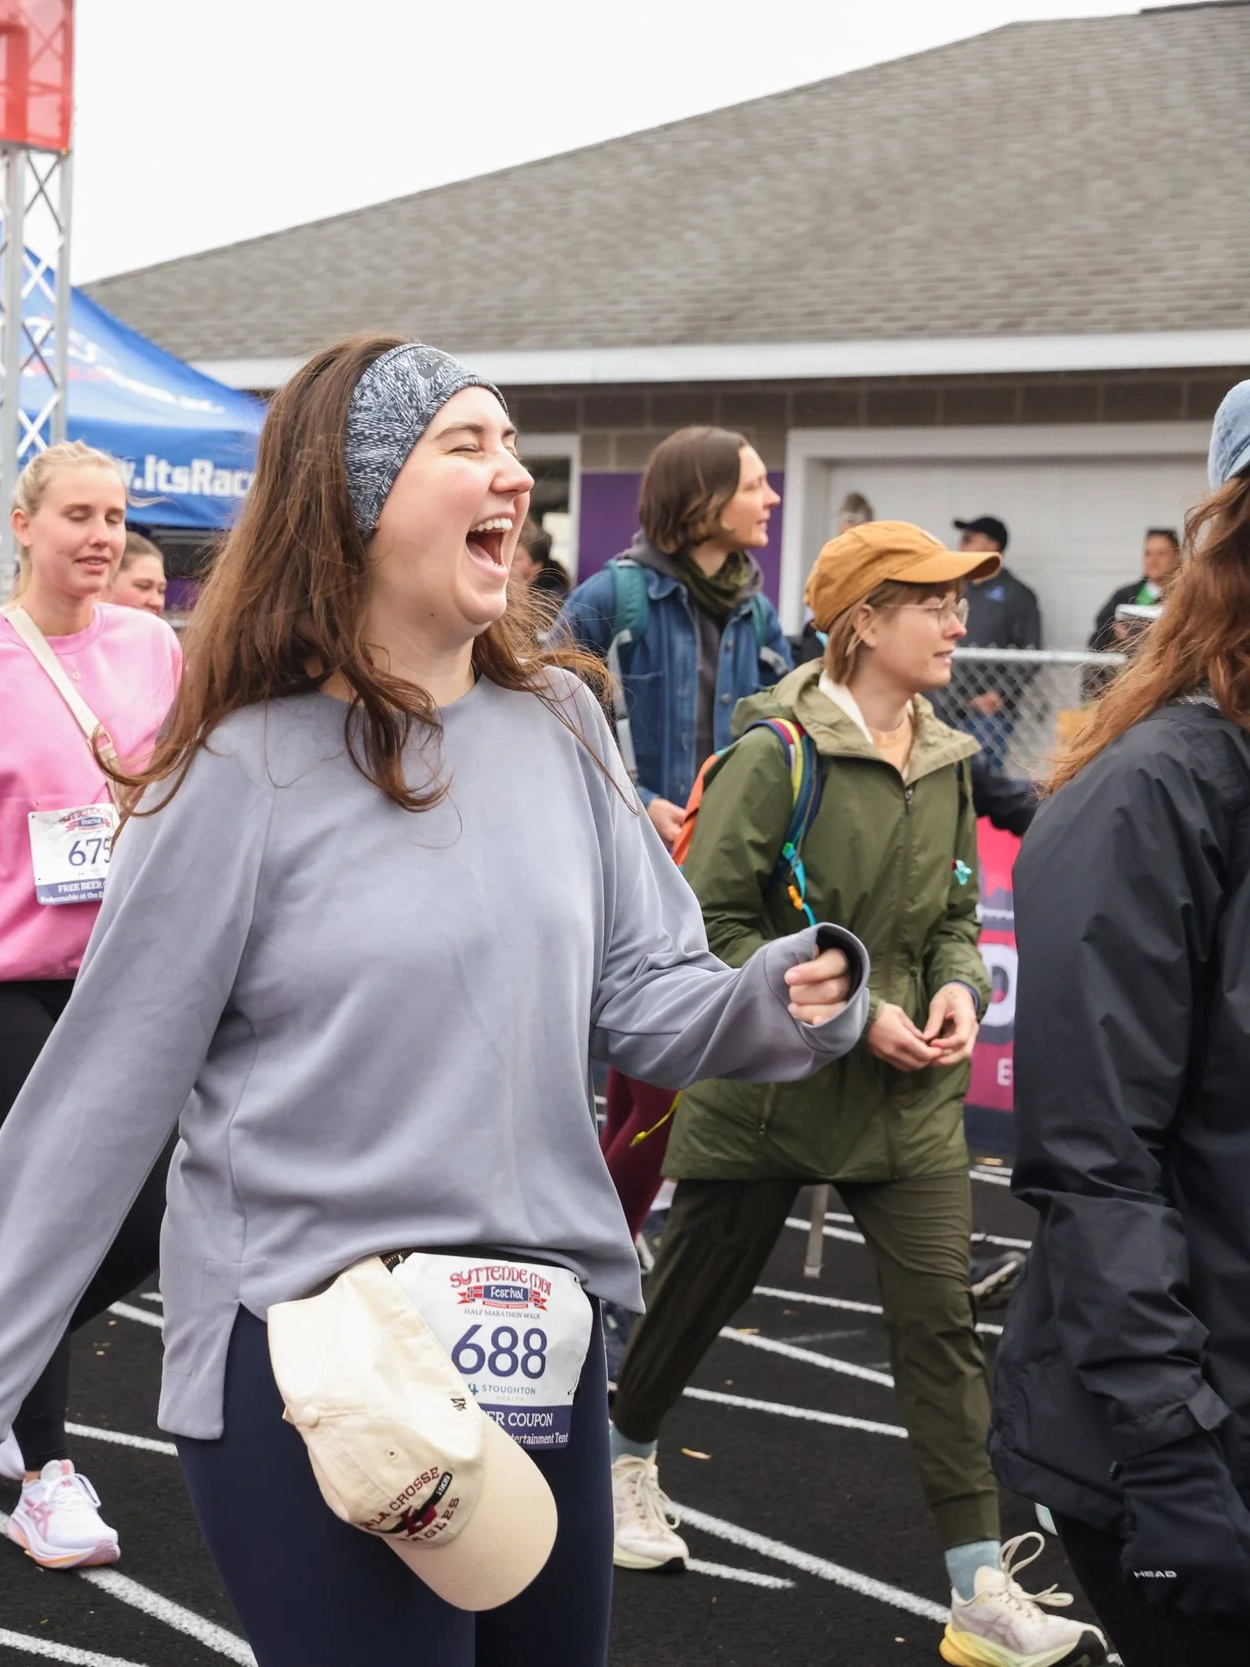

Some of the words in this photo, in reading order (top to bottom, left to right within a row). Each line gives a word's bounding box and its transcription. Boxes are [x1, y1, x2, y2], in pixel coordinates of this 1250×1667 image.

[68, 837, 111, 867] 675
[484, 1309, 522, 1318] MARATHON
[523, 1312, 541, 1320] WALK
[451, 1324, 548, 1380] 688
[482, 1384, 536, 1395] STOUGHTON
[507, 1412, 554, 1428] COUPON
[511, 1433, 554, 1445] tertainment
[554, 1432, 569, 1444] Tent
[390, 1466, 440, 1512] CROSSE
[1133, 1570, 1178, 1579] HEAD
